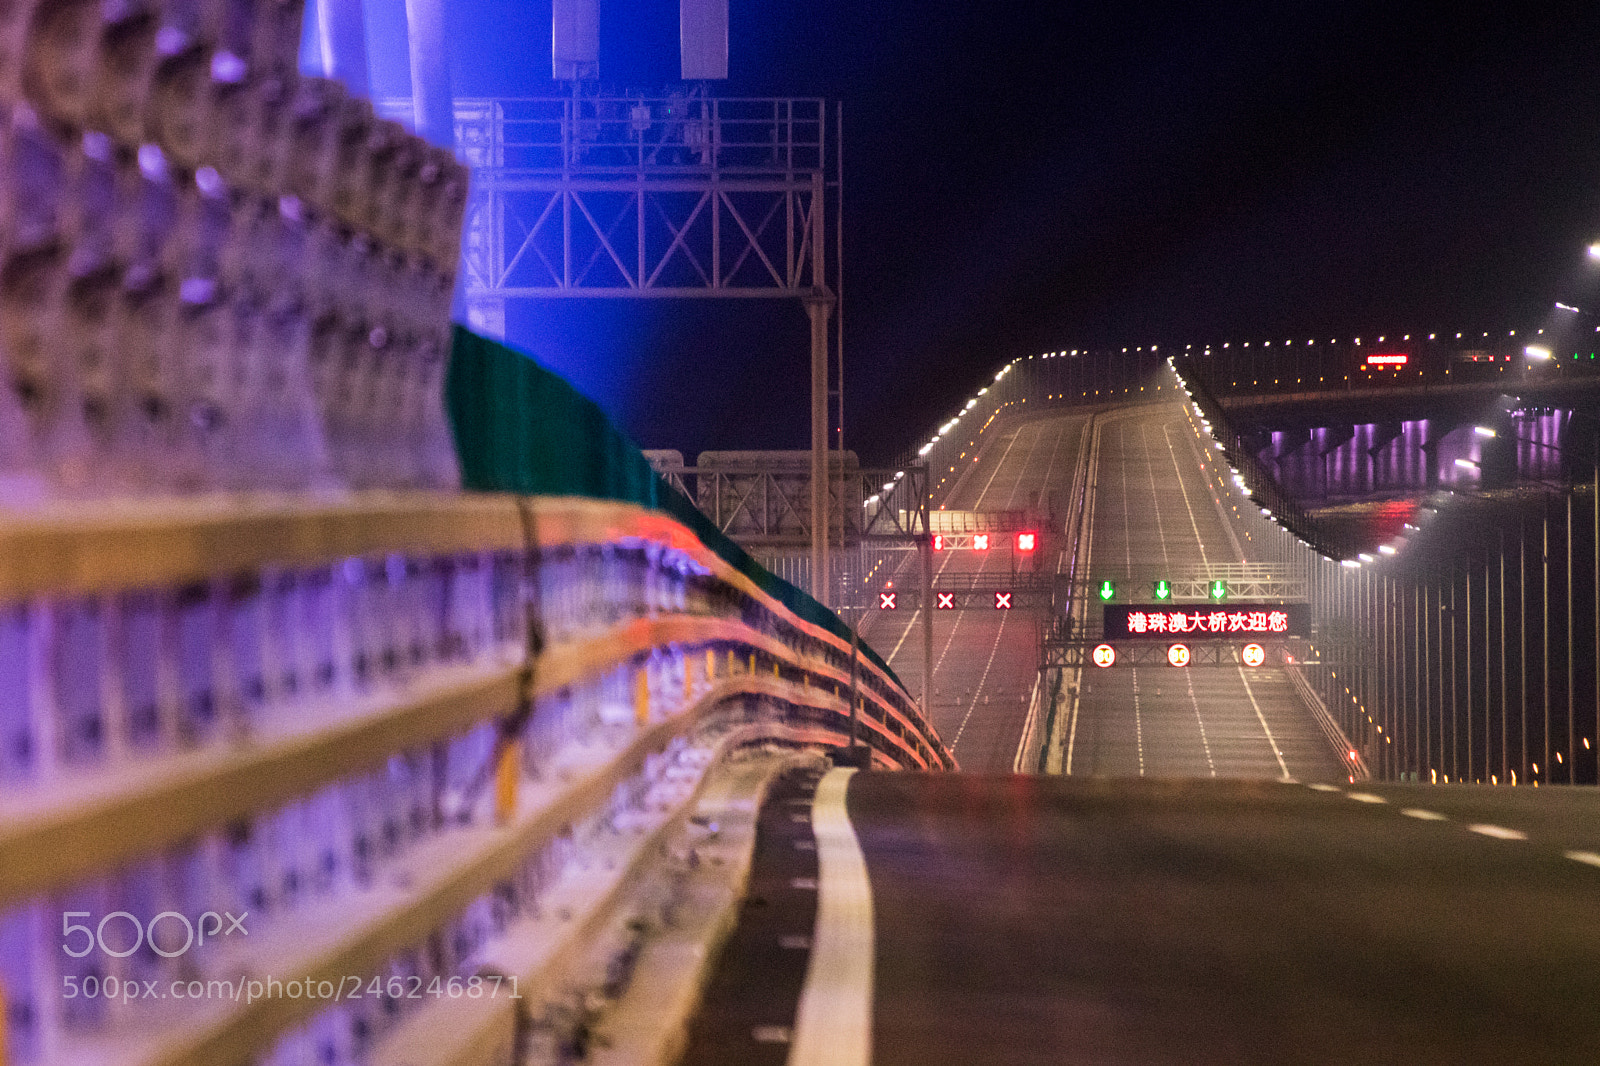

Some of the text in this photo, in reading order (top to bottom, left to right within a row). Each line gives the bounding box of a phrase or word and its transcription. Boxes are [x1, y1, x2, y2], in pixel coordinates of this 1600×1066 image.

[1127, 611, 1288, 633] 港珠澳大桥欢迎您
